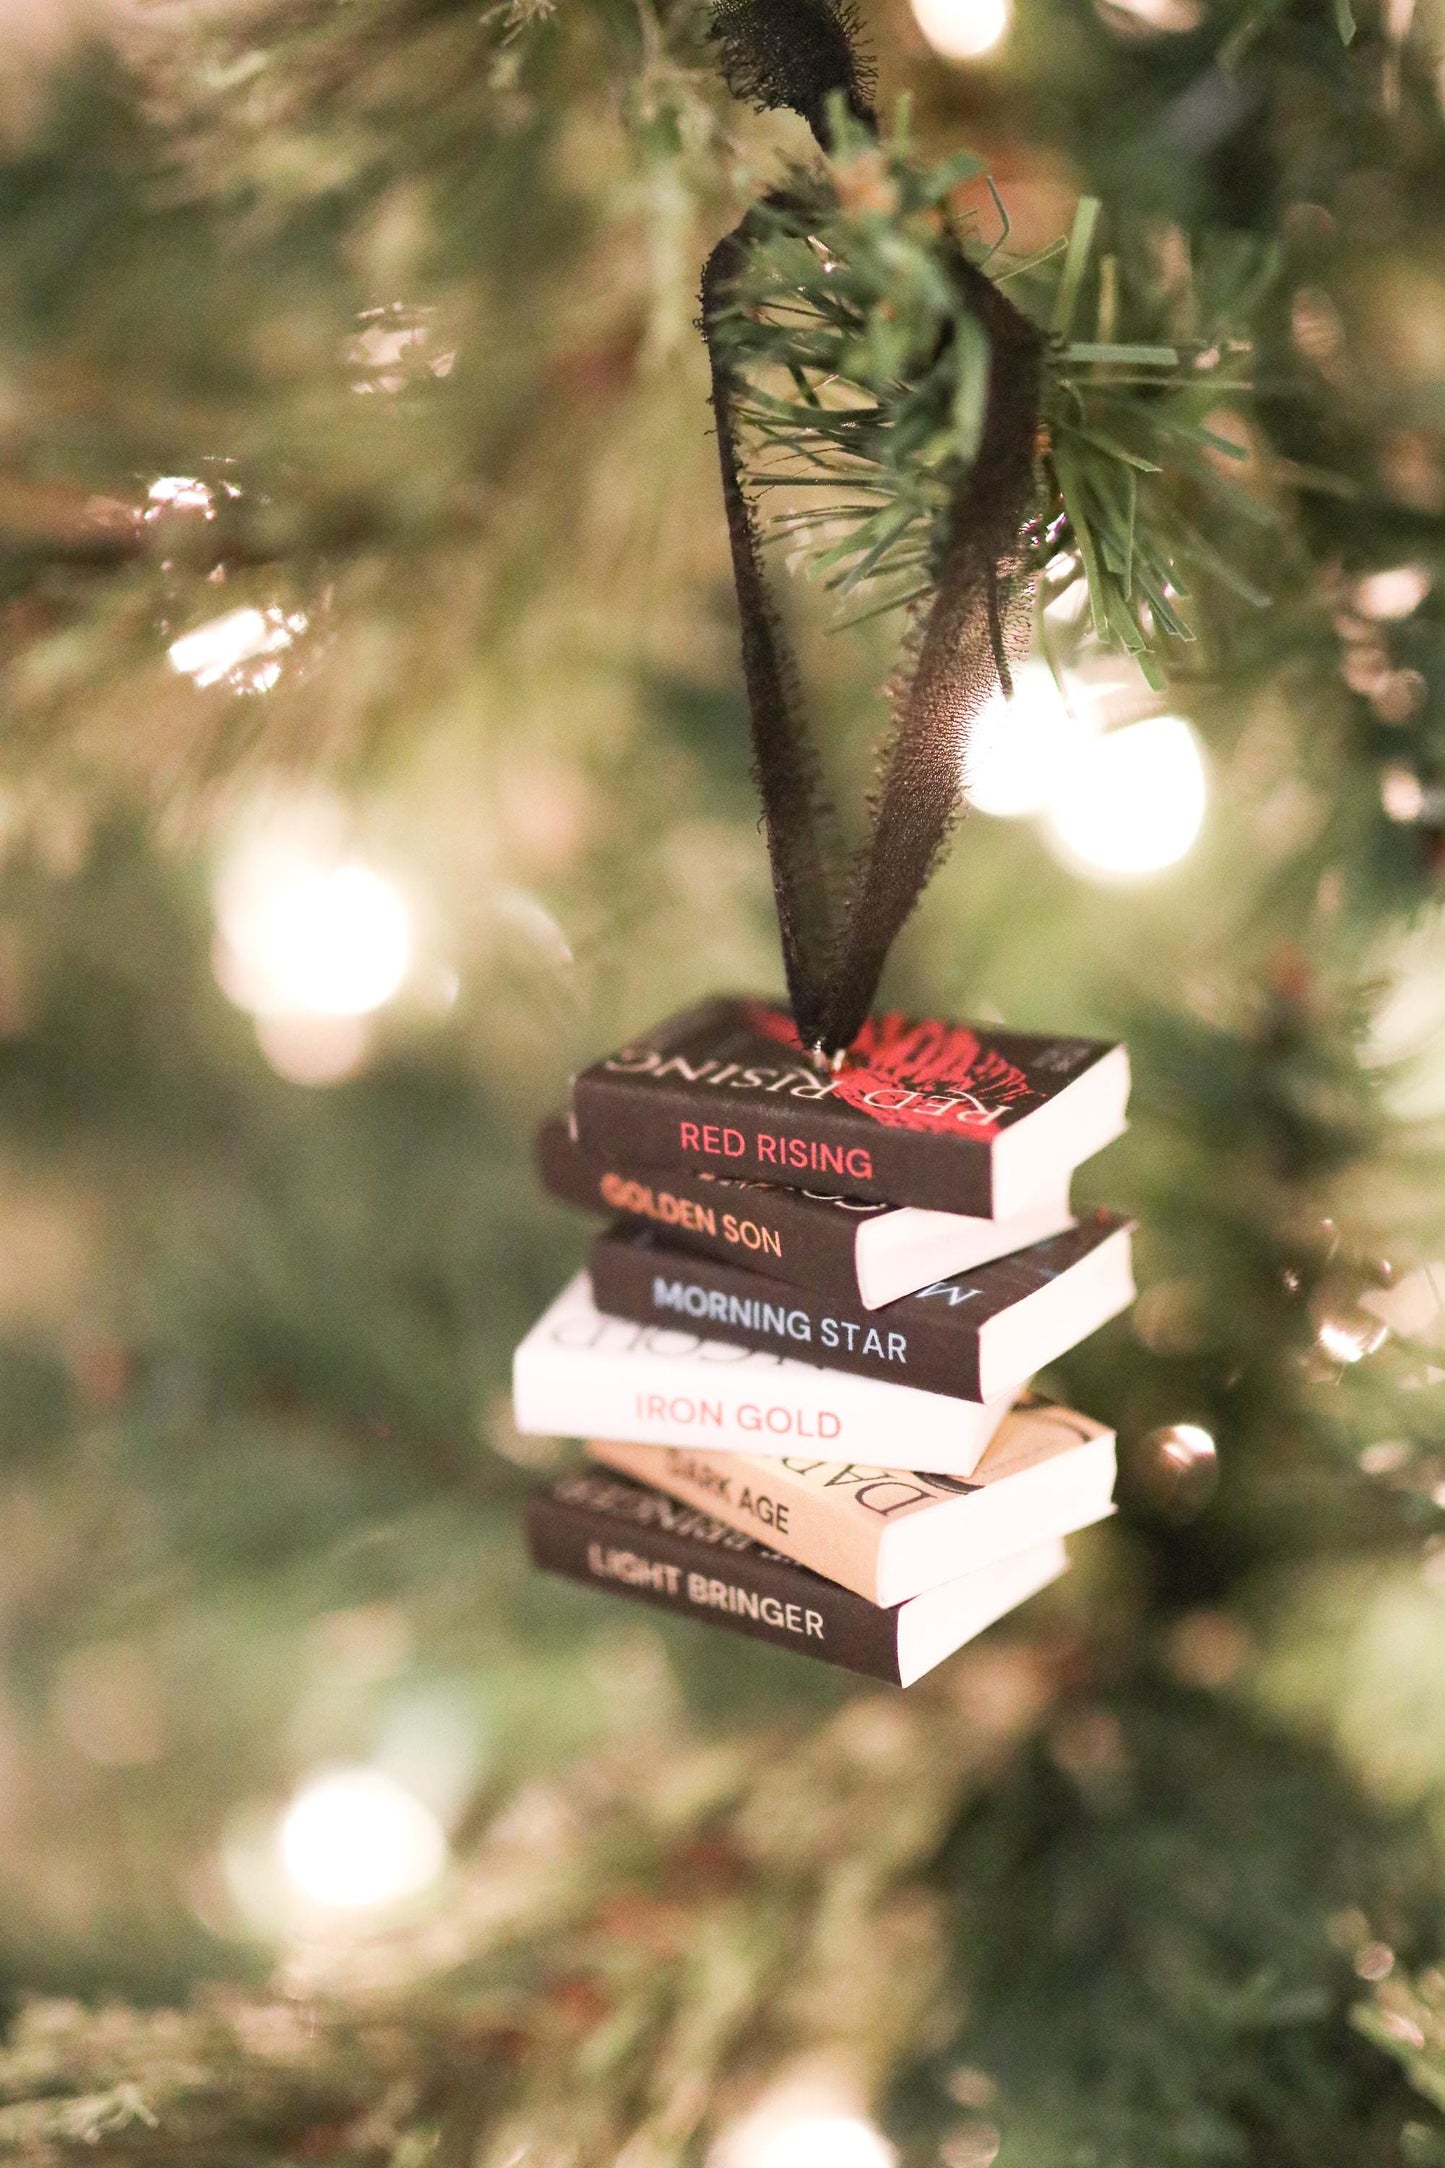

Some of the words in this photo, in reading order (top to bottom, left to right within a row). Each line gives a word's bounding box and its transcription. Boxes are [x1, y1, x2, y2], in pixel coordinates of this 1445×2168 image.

[606, 1049, 843, 1100] RISING
[864, 1089, 1013, 1126] RED
[680, 1122, 746, 1157] RED
[756, 1133, 874, 1180] RISING
[600, 1172, 717, 1237] GOLDEN
[722, 1214, 783, 1258] SON
[652, 1275, 811, 1342] MORNING
[820, 1317, 908, 1364] STAR
[635, 1392, 724, 1428] IRON
[736, 1403, 842, 1439] GOLD
[738, 1486, 790, 1535] AGE
[587, 1542, 682, 1595] LIGHT
[686, 1572, 825, 1640] BRINGER
